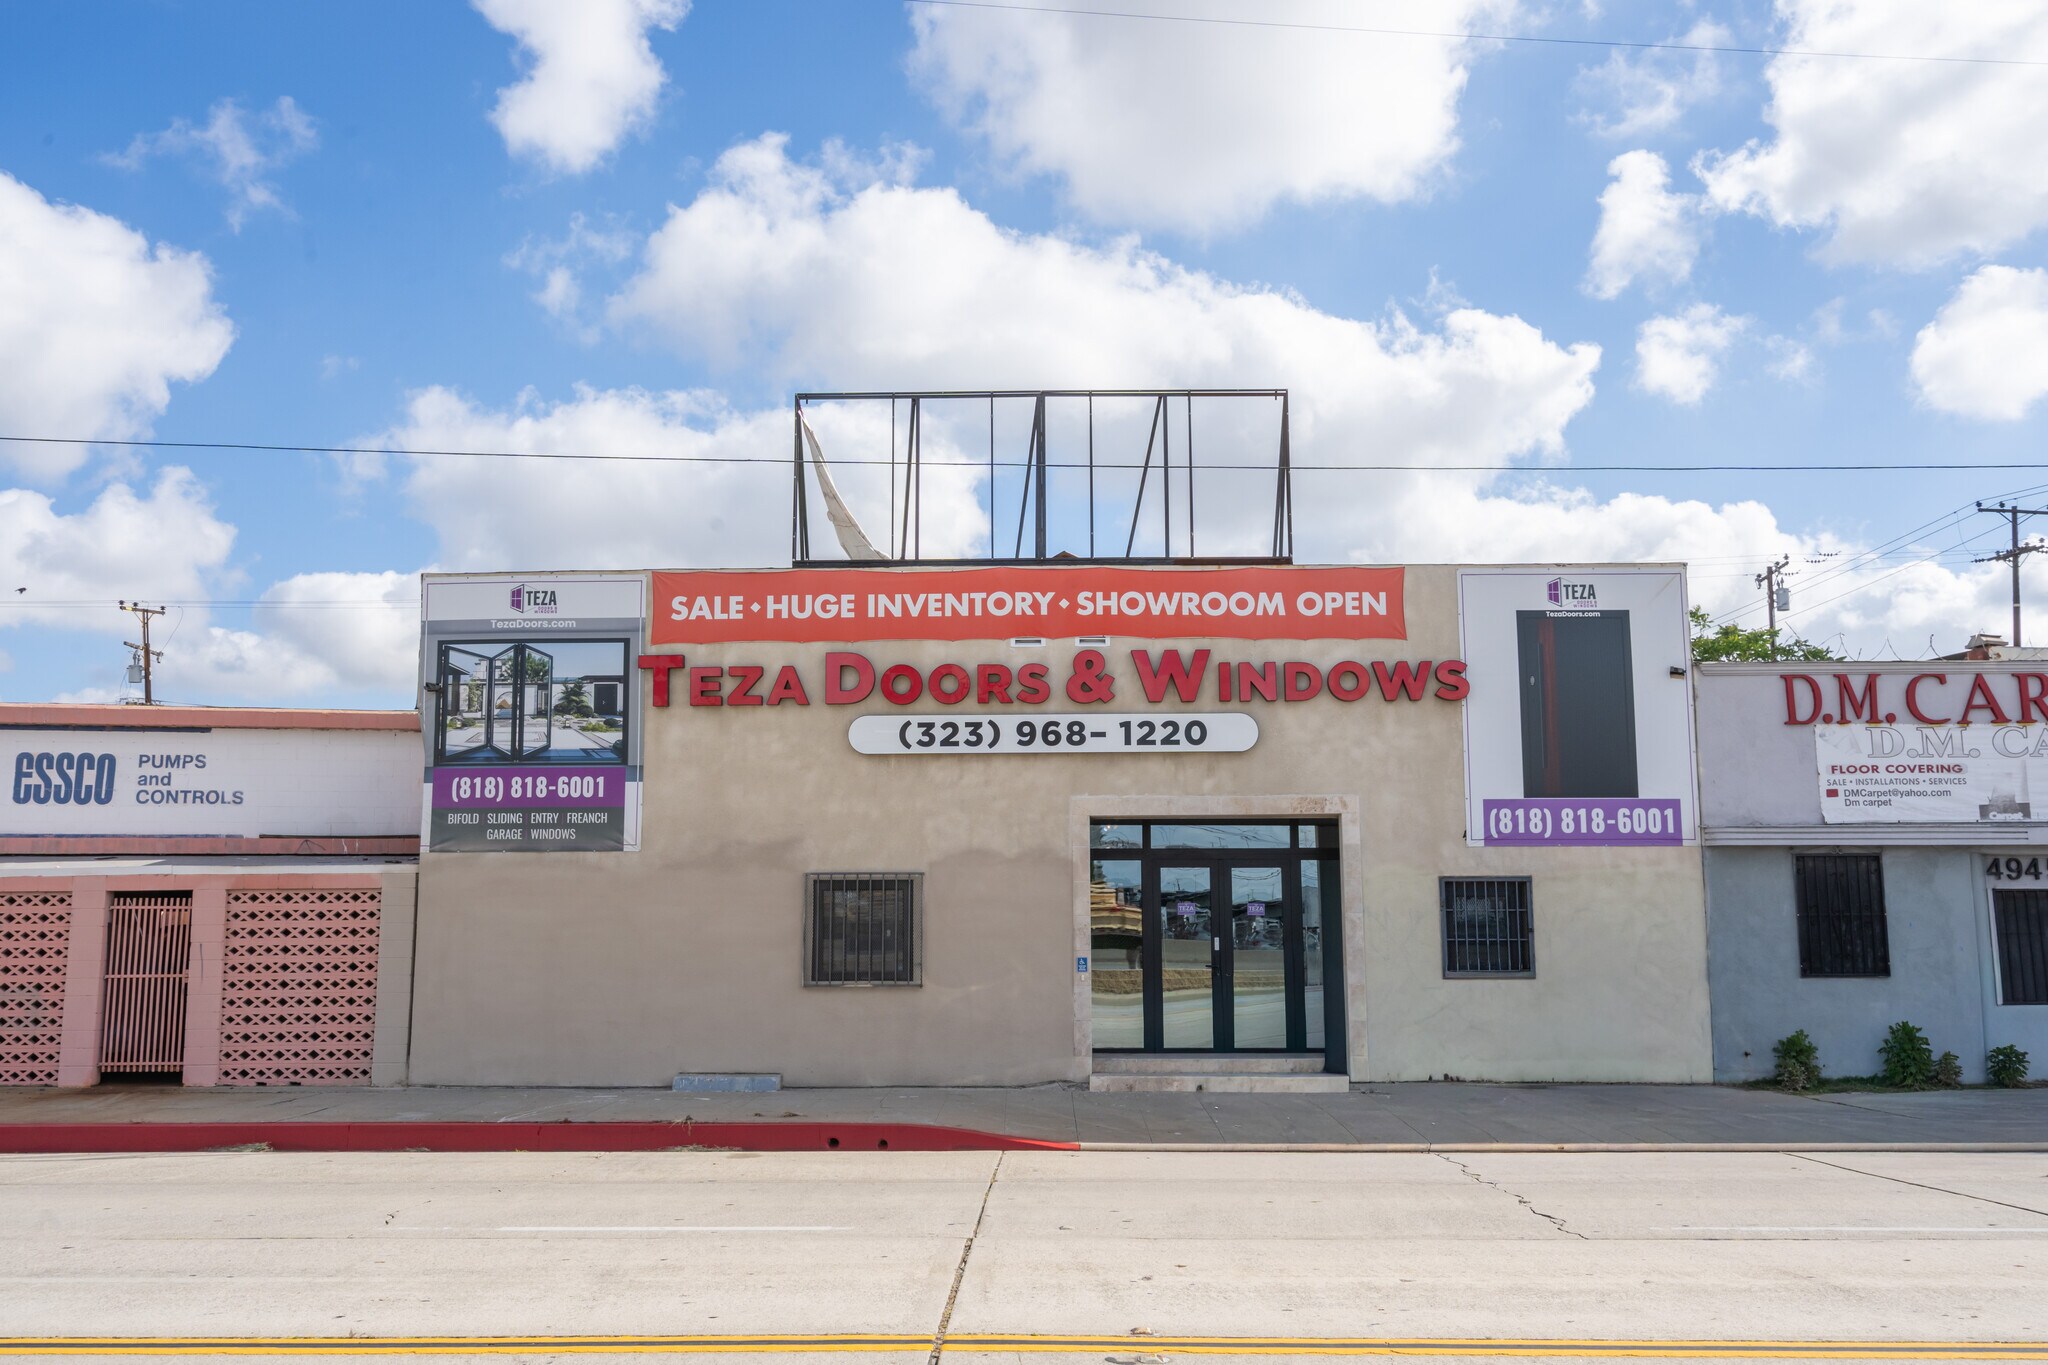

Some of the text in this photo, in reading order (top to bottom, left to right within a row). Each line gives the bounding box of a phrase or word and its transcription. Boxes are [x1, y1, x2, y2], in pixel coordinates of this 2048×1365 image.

[526, 591, 557, 606] TEZA
[1563, 584, 1596, 599] TEZA
[671, 591, 1387, 620] SALE HUGE INVENTORY SHOWROOM OPEN
[490, 620, 576, 628] TezaDoors.com
[638, 648, 1471, 707] TEZA DOORS & WINDOWS
[1780, 673, 1897, 725] D.M.
[899, 720, 1001, 750] (323)
[1119, 719, 1208, 746] 1220
[1865, 726, 1981, 758] D.M.
[138, 754, 207, 769] PUMPS
[1831, 764, 1963, 774] FLOOR COVERING
[12, 752, 117, 805] ESSCO
[137, 772, 172, 786] and
[1826, 777, 1967, 786] SALE INSTALLATIONS SERVICES
[452, 776, 605, 802] (818) 818-6001
[1844, 788, 1951, 798] DMCarpet@yahoo.com
[135, 789, 244, 805] CONTROLS
[1844, 798, 1892, 808] Dm carpet
[447, 812, 608, 824] BIFOLD SLIDING ENTRY FREANCH
[1489, 807, 1675, 838] (818) 818-6001
[486, 829, 576, 840] GARAGE WINDOWS
[1986, 857, 2048, 880] 494
